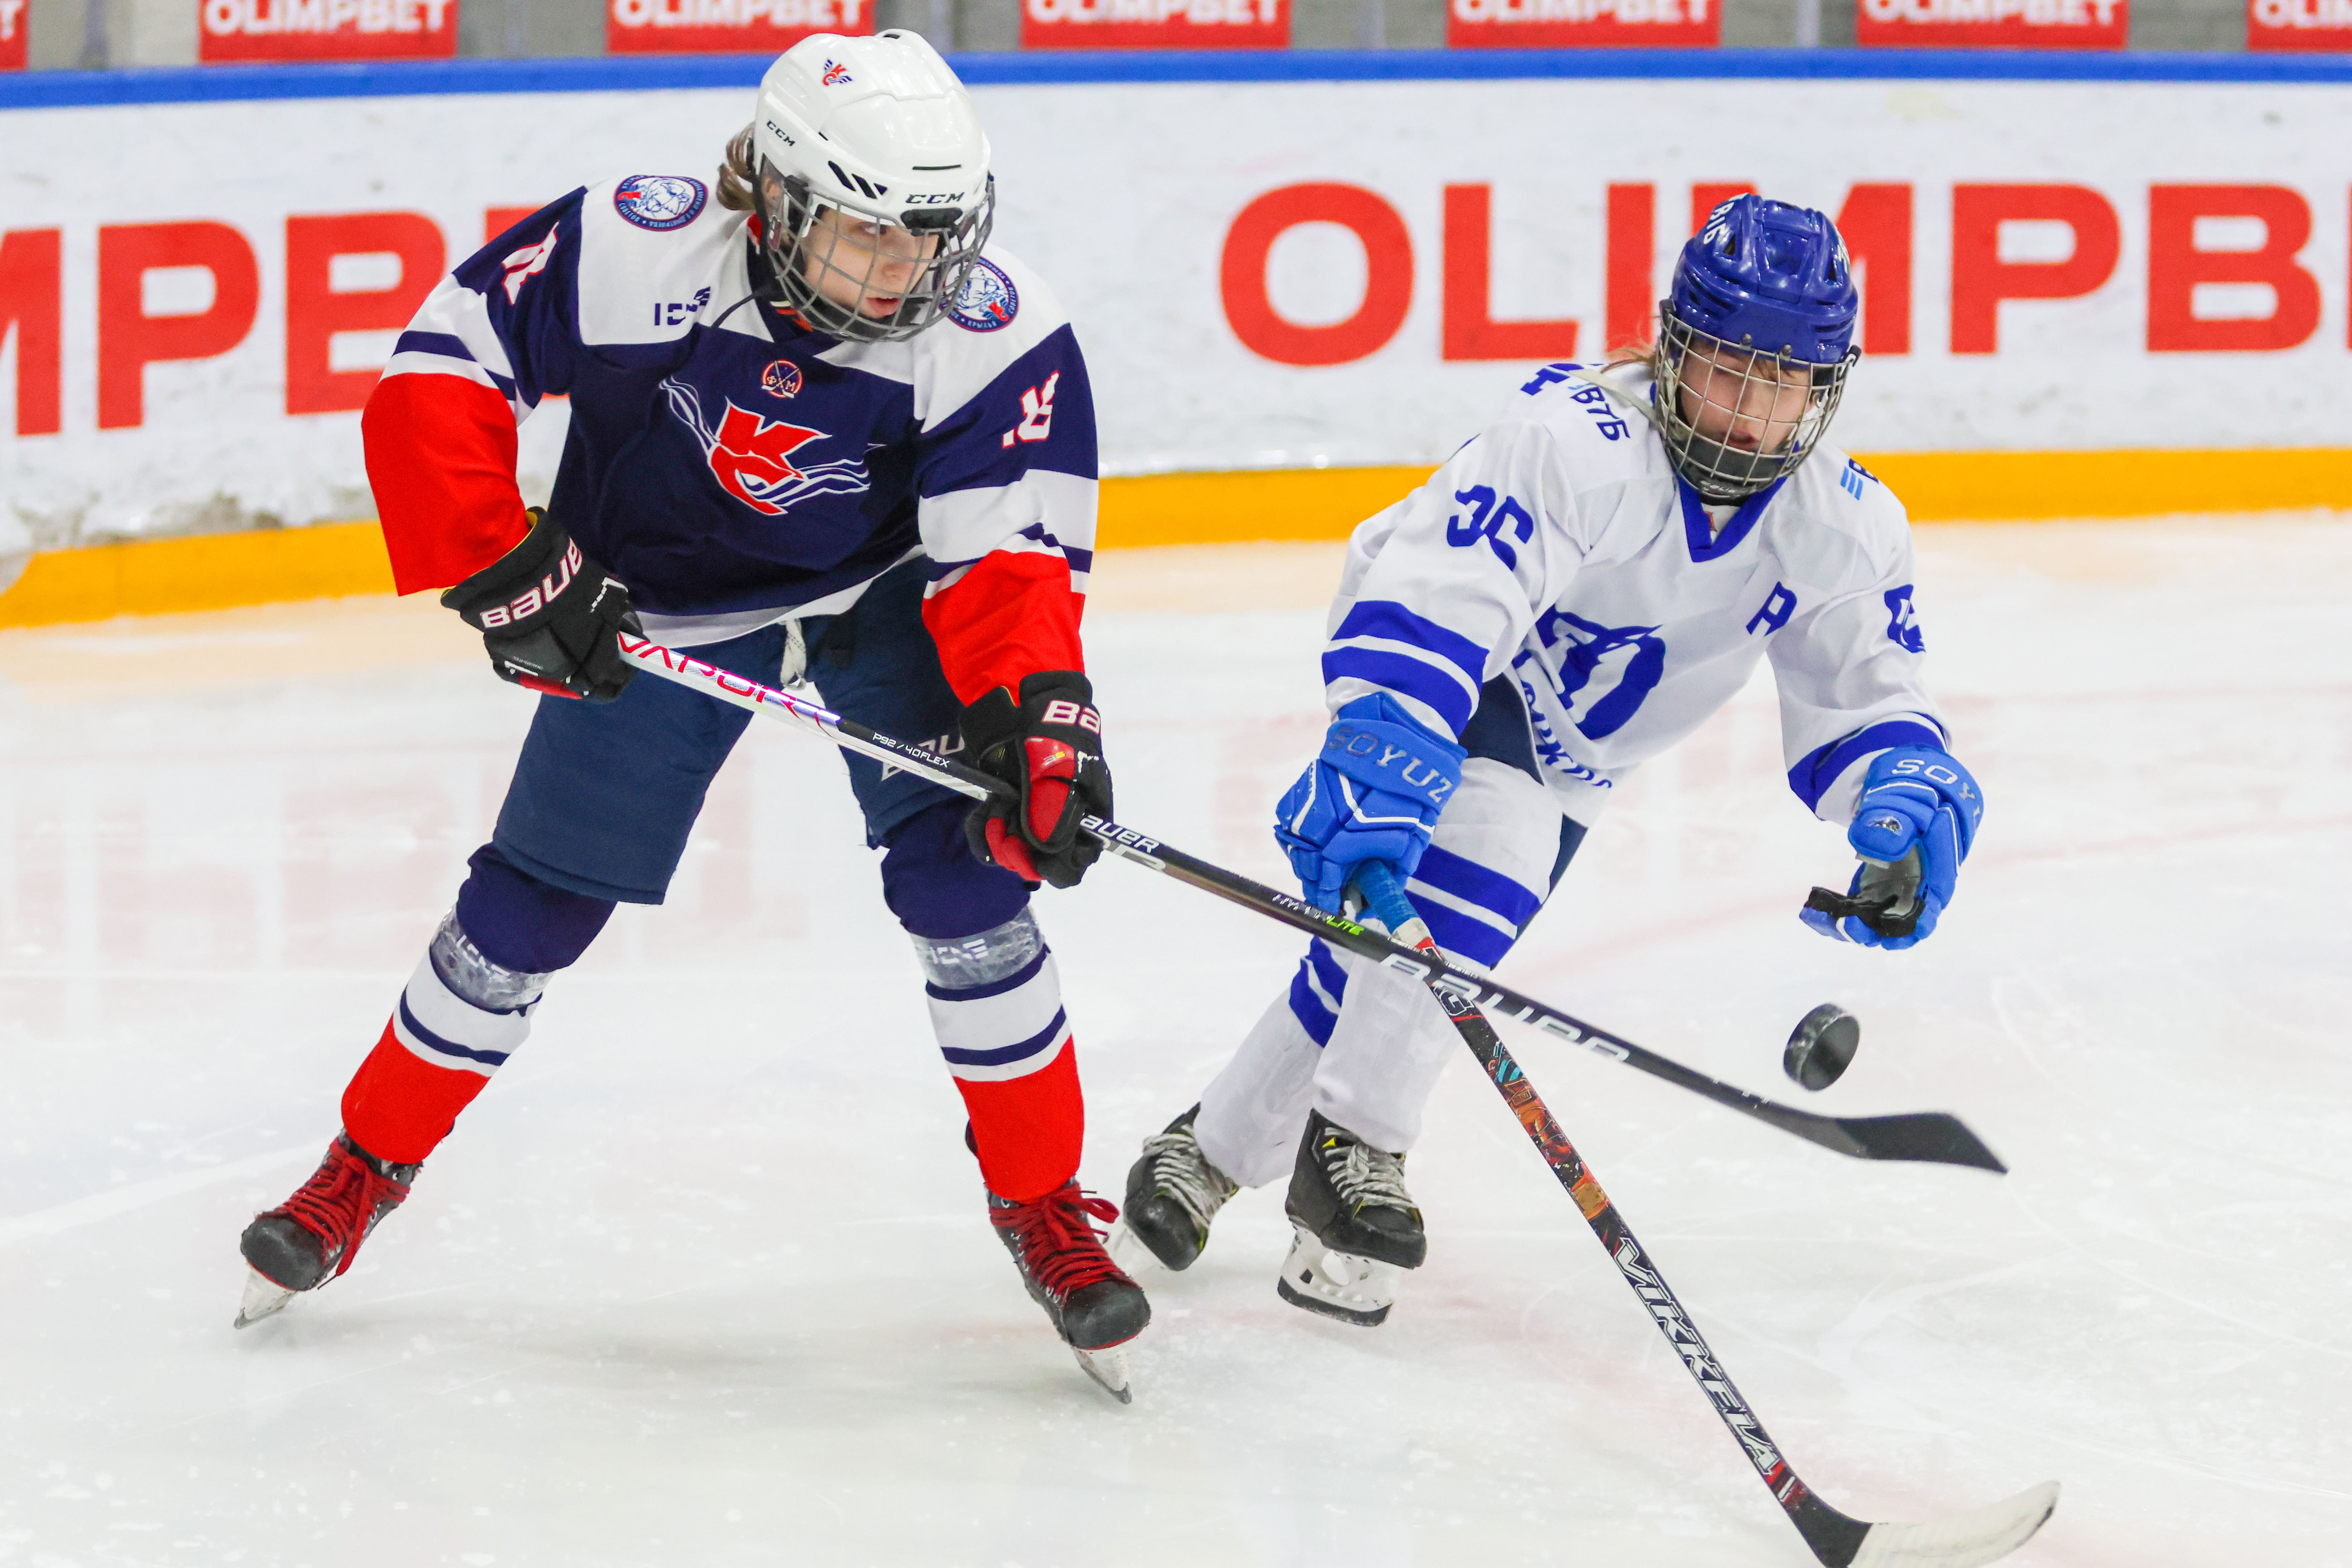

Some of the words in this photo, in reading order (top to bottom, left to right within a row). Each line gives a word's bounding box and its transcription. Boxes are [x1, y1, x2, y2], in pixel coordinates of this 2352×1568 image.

[205, 0, 453, 35] OLIMPBET
[766, 118, 796, 146] CCM
[905, 191, 966, 205] CCM
[1328, 725, 1452, 803] SOYUZ
[1080, 813, 1161, 854] AUER
[1614, 1237, 1781, 1475] VIKKELA
